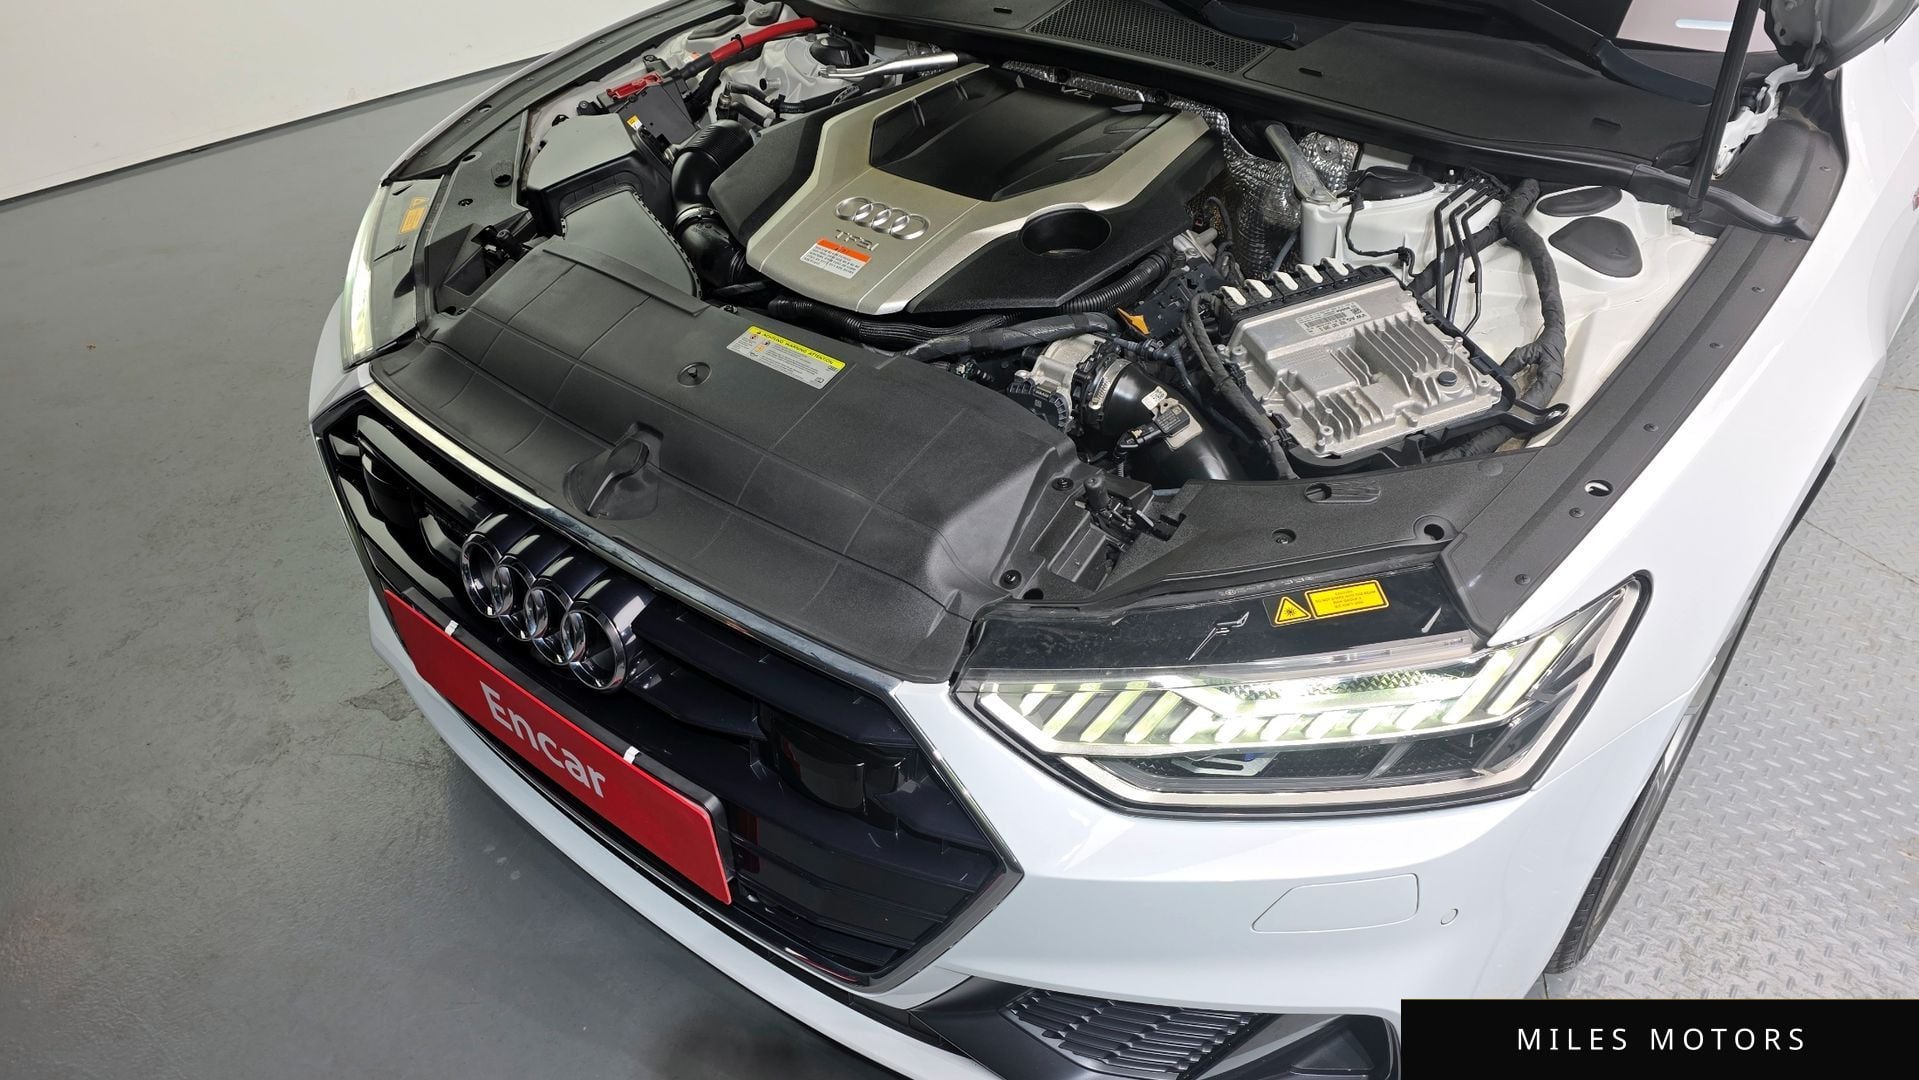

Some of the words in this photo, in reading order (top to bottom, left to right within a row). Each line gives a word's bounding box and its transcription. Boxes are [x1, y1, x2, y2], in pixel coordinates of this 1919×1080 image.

[835, 229, 879, 251] TFSI
[785, 341, 807, 353] WARNING
[808, 351, 834, 365] ATTENTION
[479, 680, 606, 799] Encar
